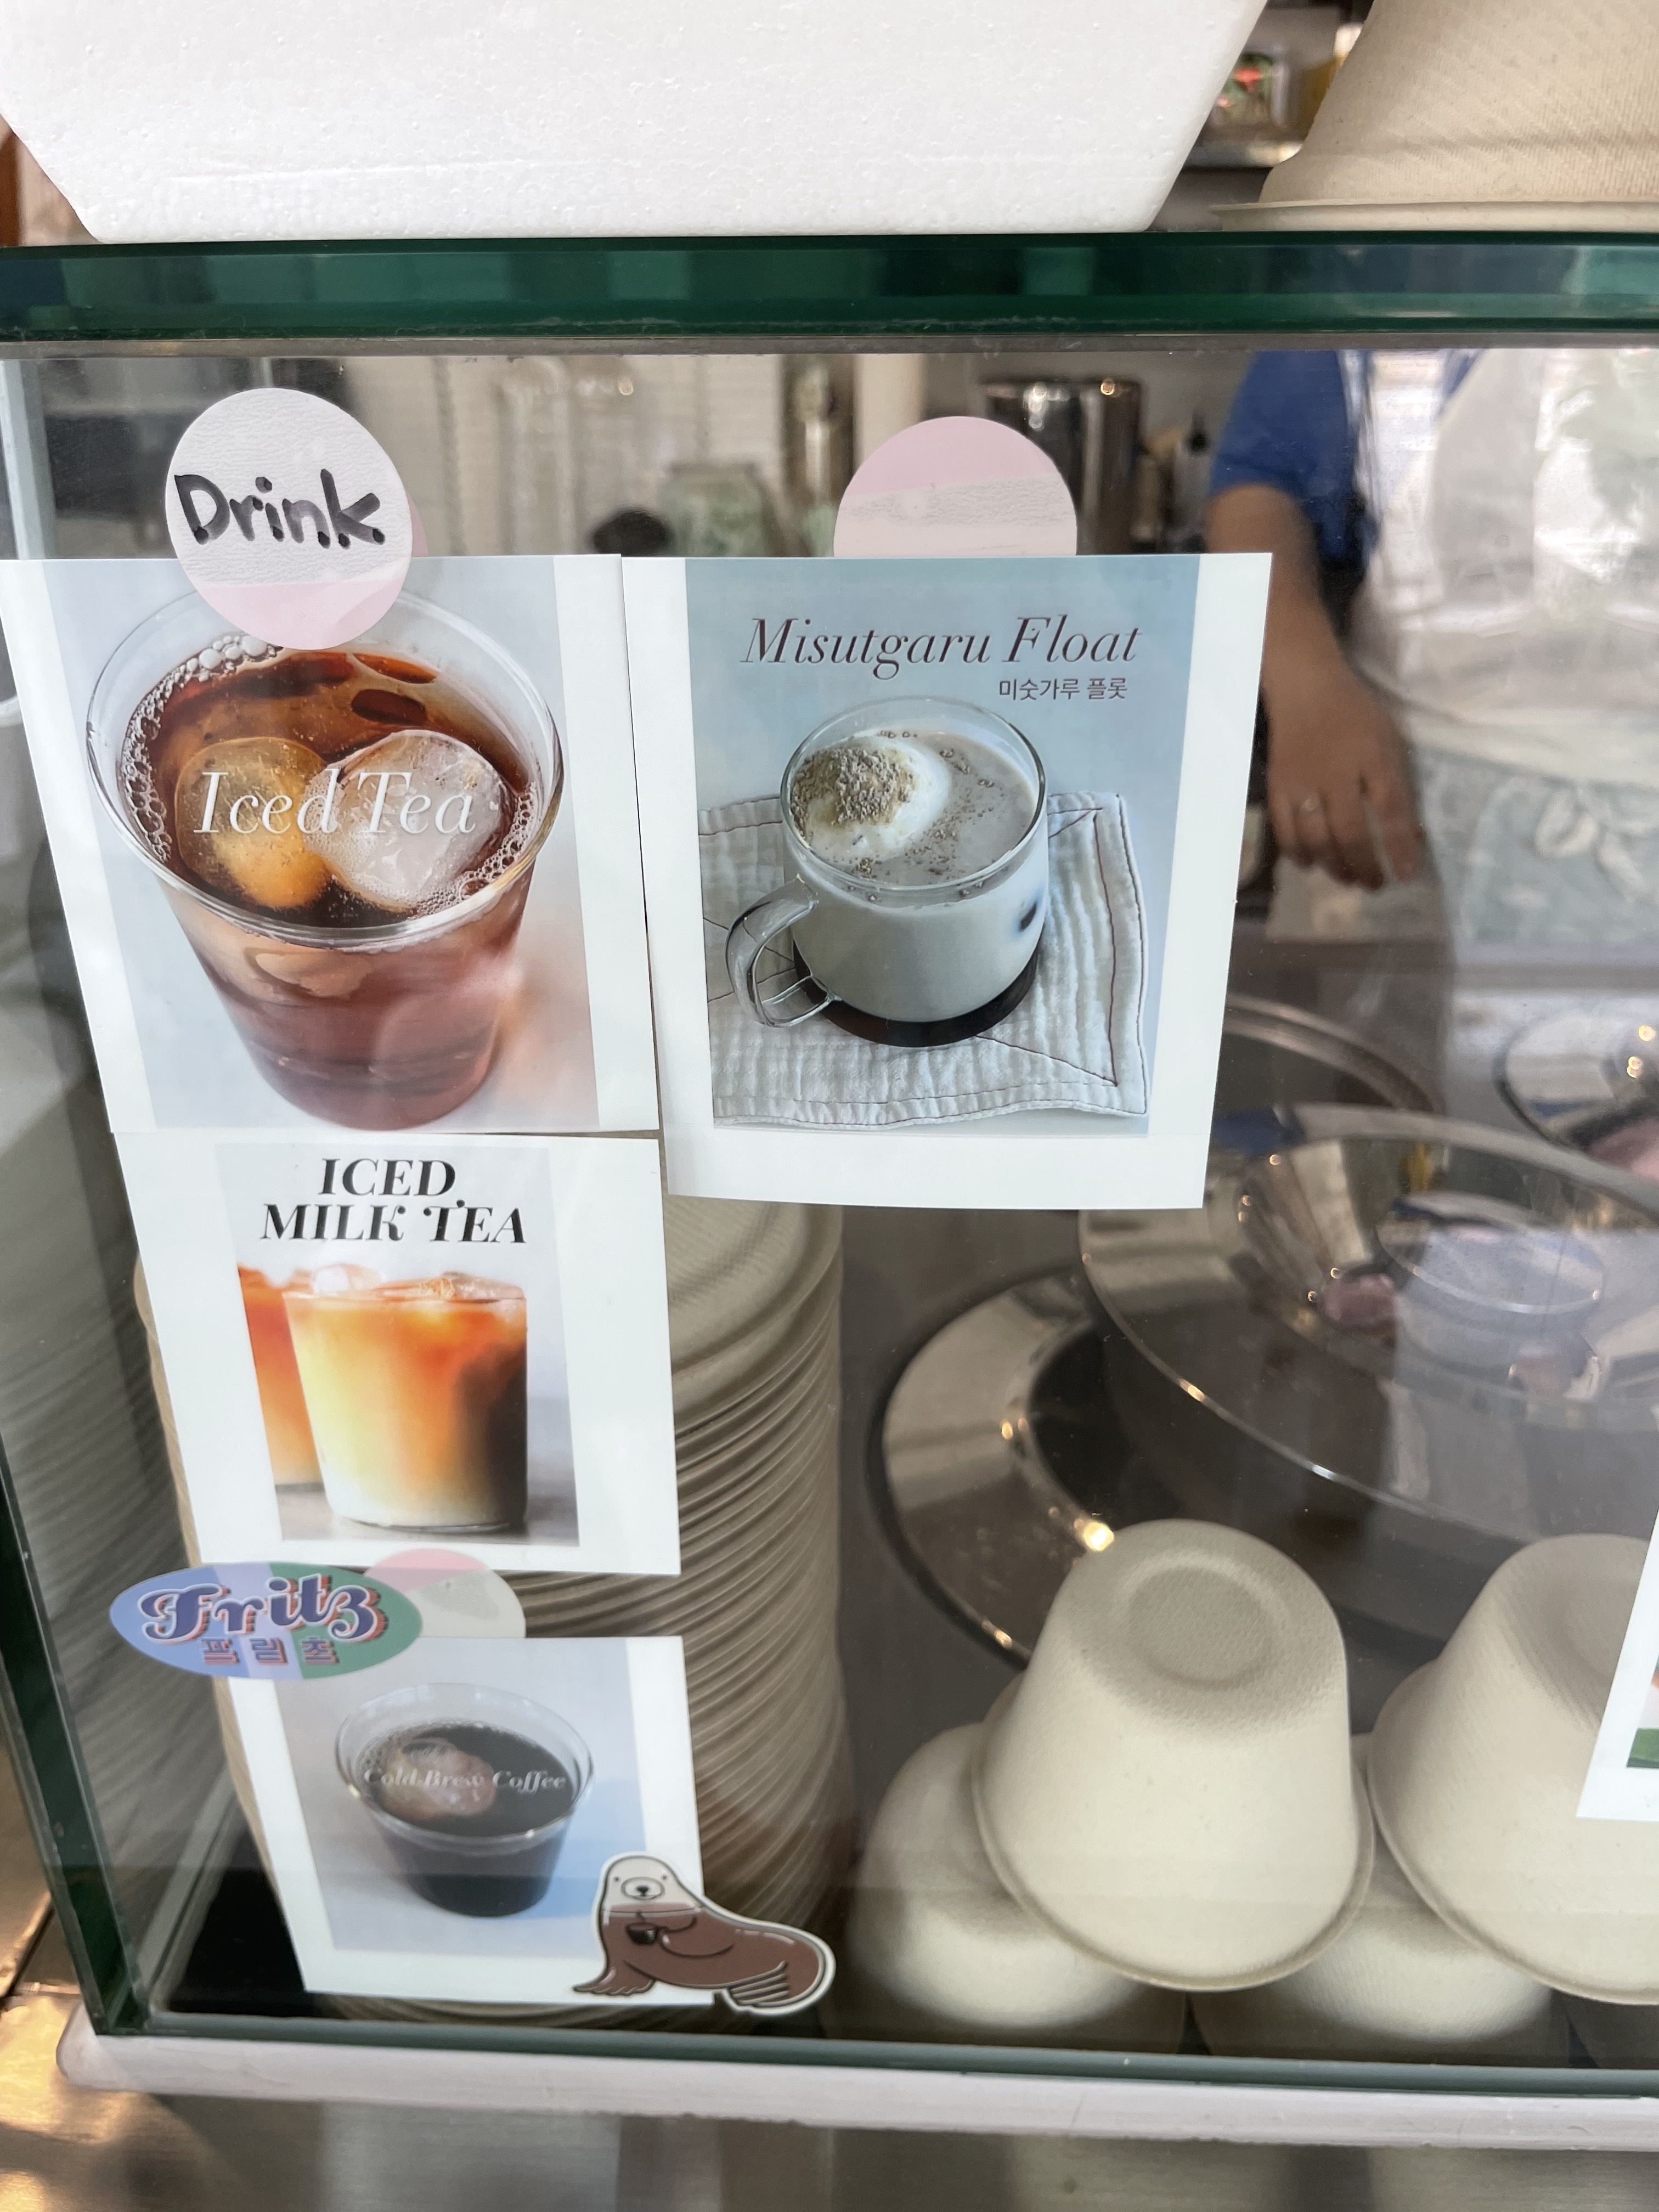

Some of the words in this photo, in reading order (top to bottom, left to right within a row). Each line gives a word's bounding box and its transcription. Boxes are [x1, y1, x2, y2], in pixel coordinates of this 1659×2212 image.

[173, 468, 386, 549] Drink
[741, 617, 991, 680] Misutgaru
[1002, 614, 1144, 663] Float
[999, 678, 1080, 701] 미숫가루
[1087, 678, 1128, 700] 플롯
[193, 768, 340, 834] Iced
[357, 771, 476, 834] Tea
[318, 1158, 456, 1196] ICED
[259, 1203, 406, 1242] MILK
[423, 1199, 527, 1244] TEA
[138, 1573, 388, 1644] Fritz
[364, 1767, 419, 1787] Cold
[422, 1769, 486, 1788] Brew
[493, 1770, 567, 1794] Coffee
